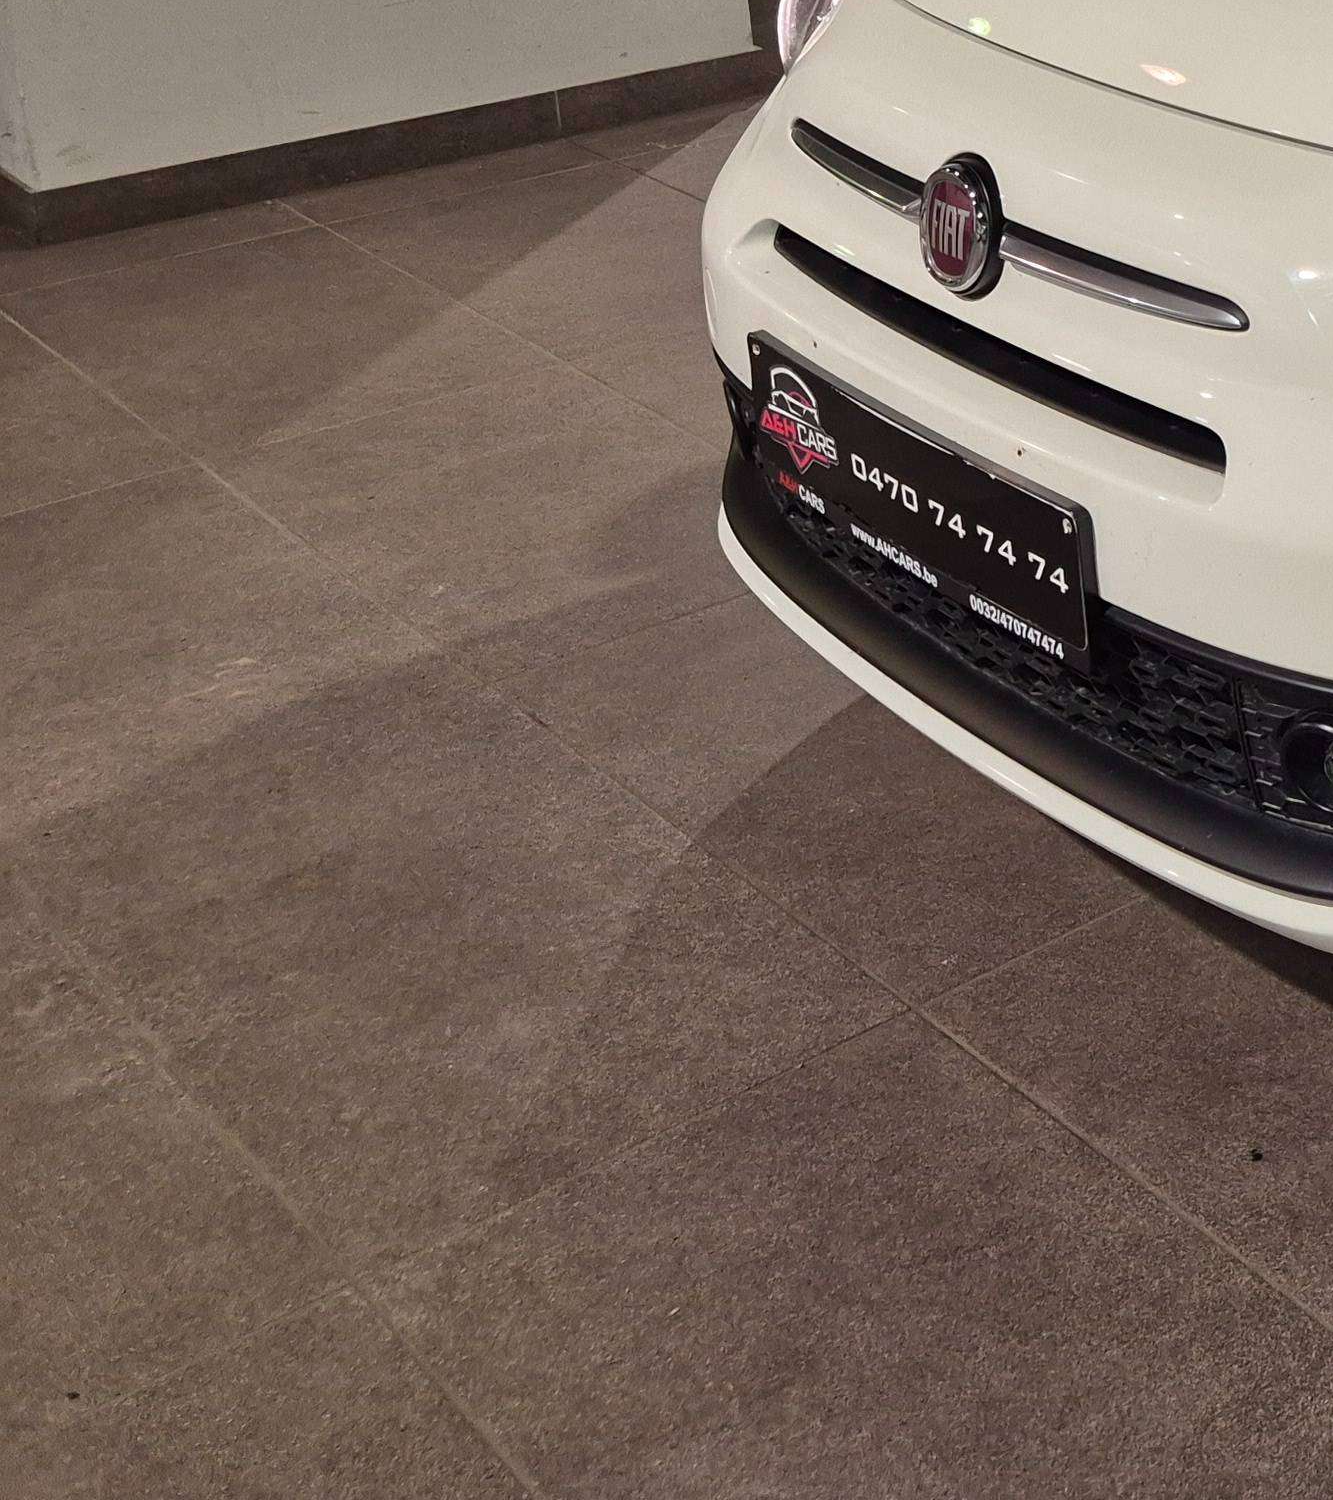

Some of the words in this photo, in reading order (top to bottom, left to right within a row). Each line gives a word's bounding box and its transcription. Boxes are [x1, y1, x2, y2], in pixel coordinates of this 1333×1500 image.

[930, 197, 971, 261] FIAT
[850, 522, 939, 588] www.AHCARS.be
[851, 452, 919, 514] 0470
[928, 498, 967, 539] 74
[976, 523, 1017, 567] 74
[1027, 551, 1070, 594] 74
[968, 593, 1065, 660] 0032/470747474
